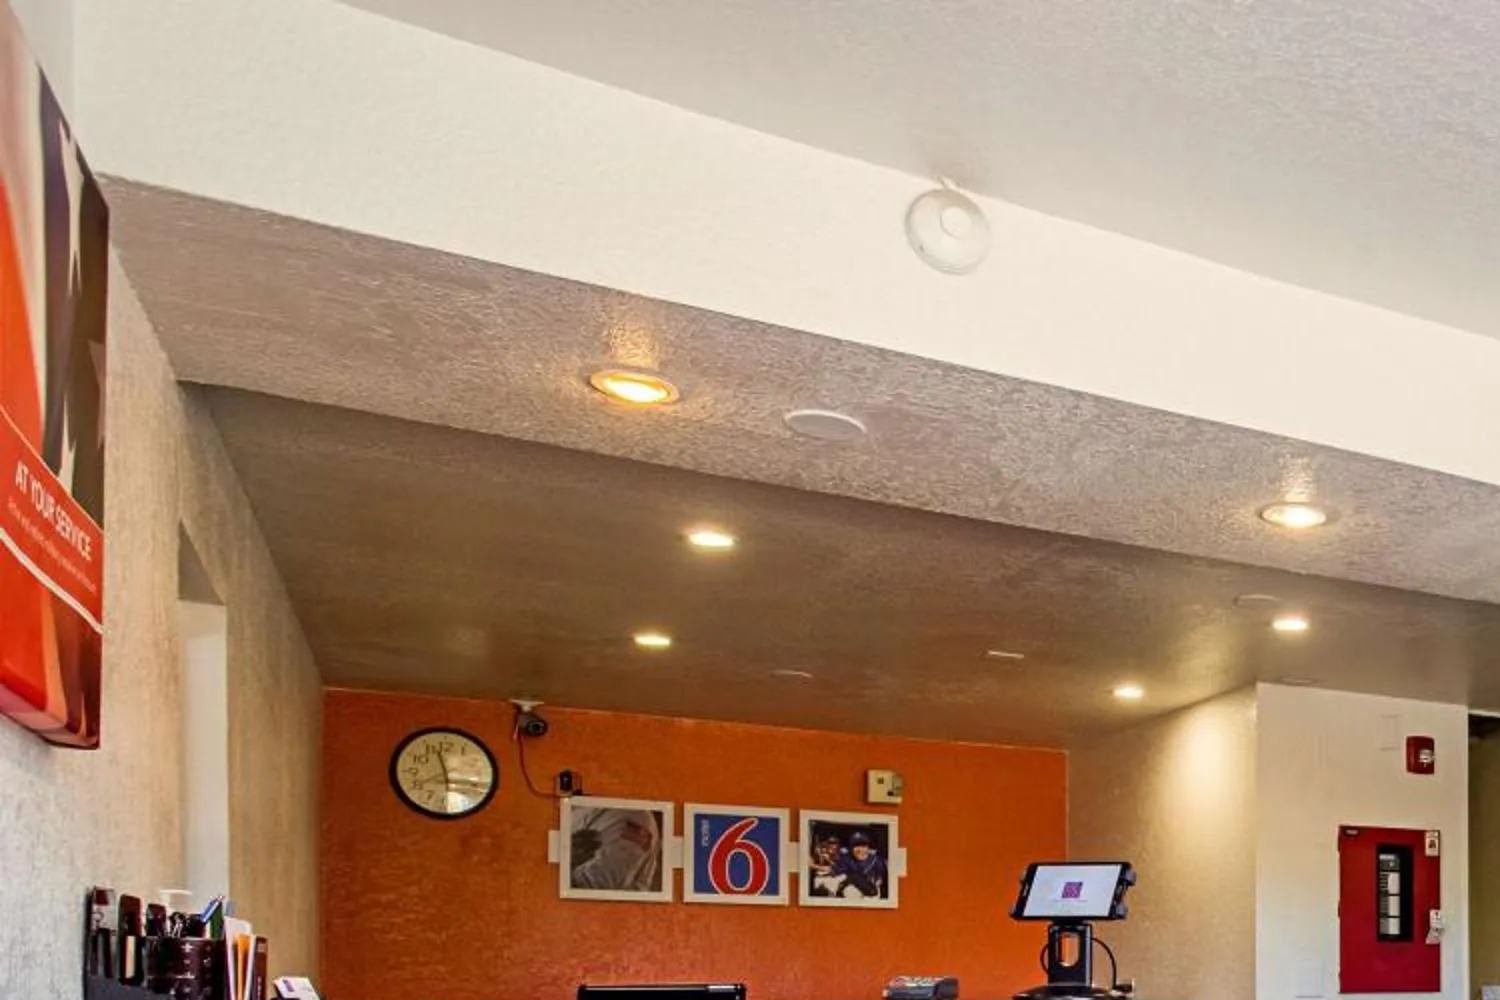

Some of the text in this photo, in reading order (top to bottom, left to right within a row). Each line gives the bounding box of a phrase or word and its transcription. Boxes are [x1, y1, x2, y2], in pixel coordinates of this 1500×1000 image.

[15, 459, 29, 494] AT
[55, 502, 92, 562] SERVICE
[708, 817, 769, 897] 6
